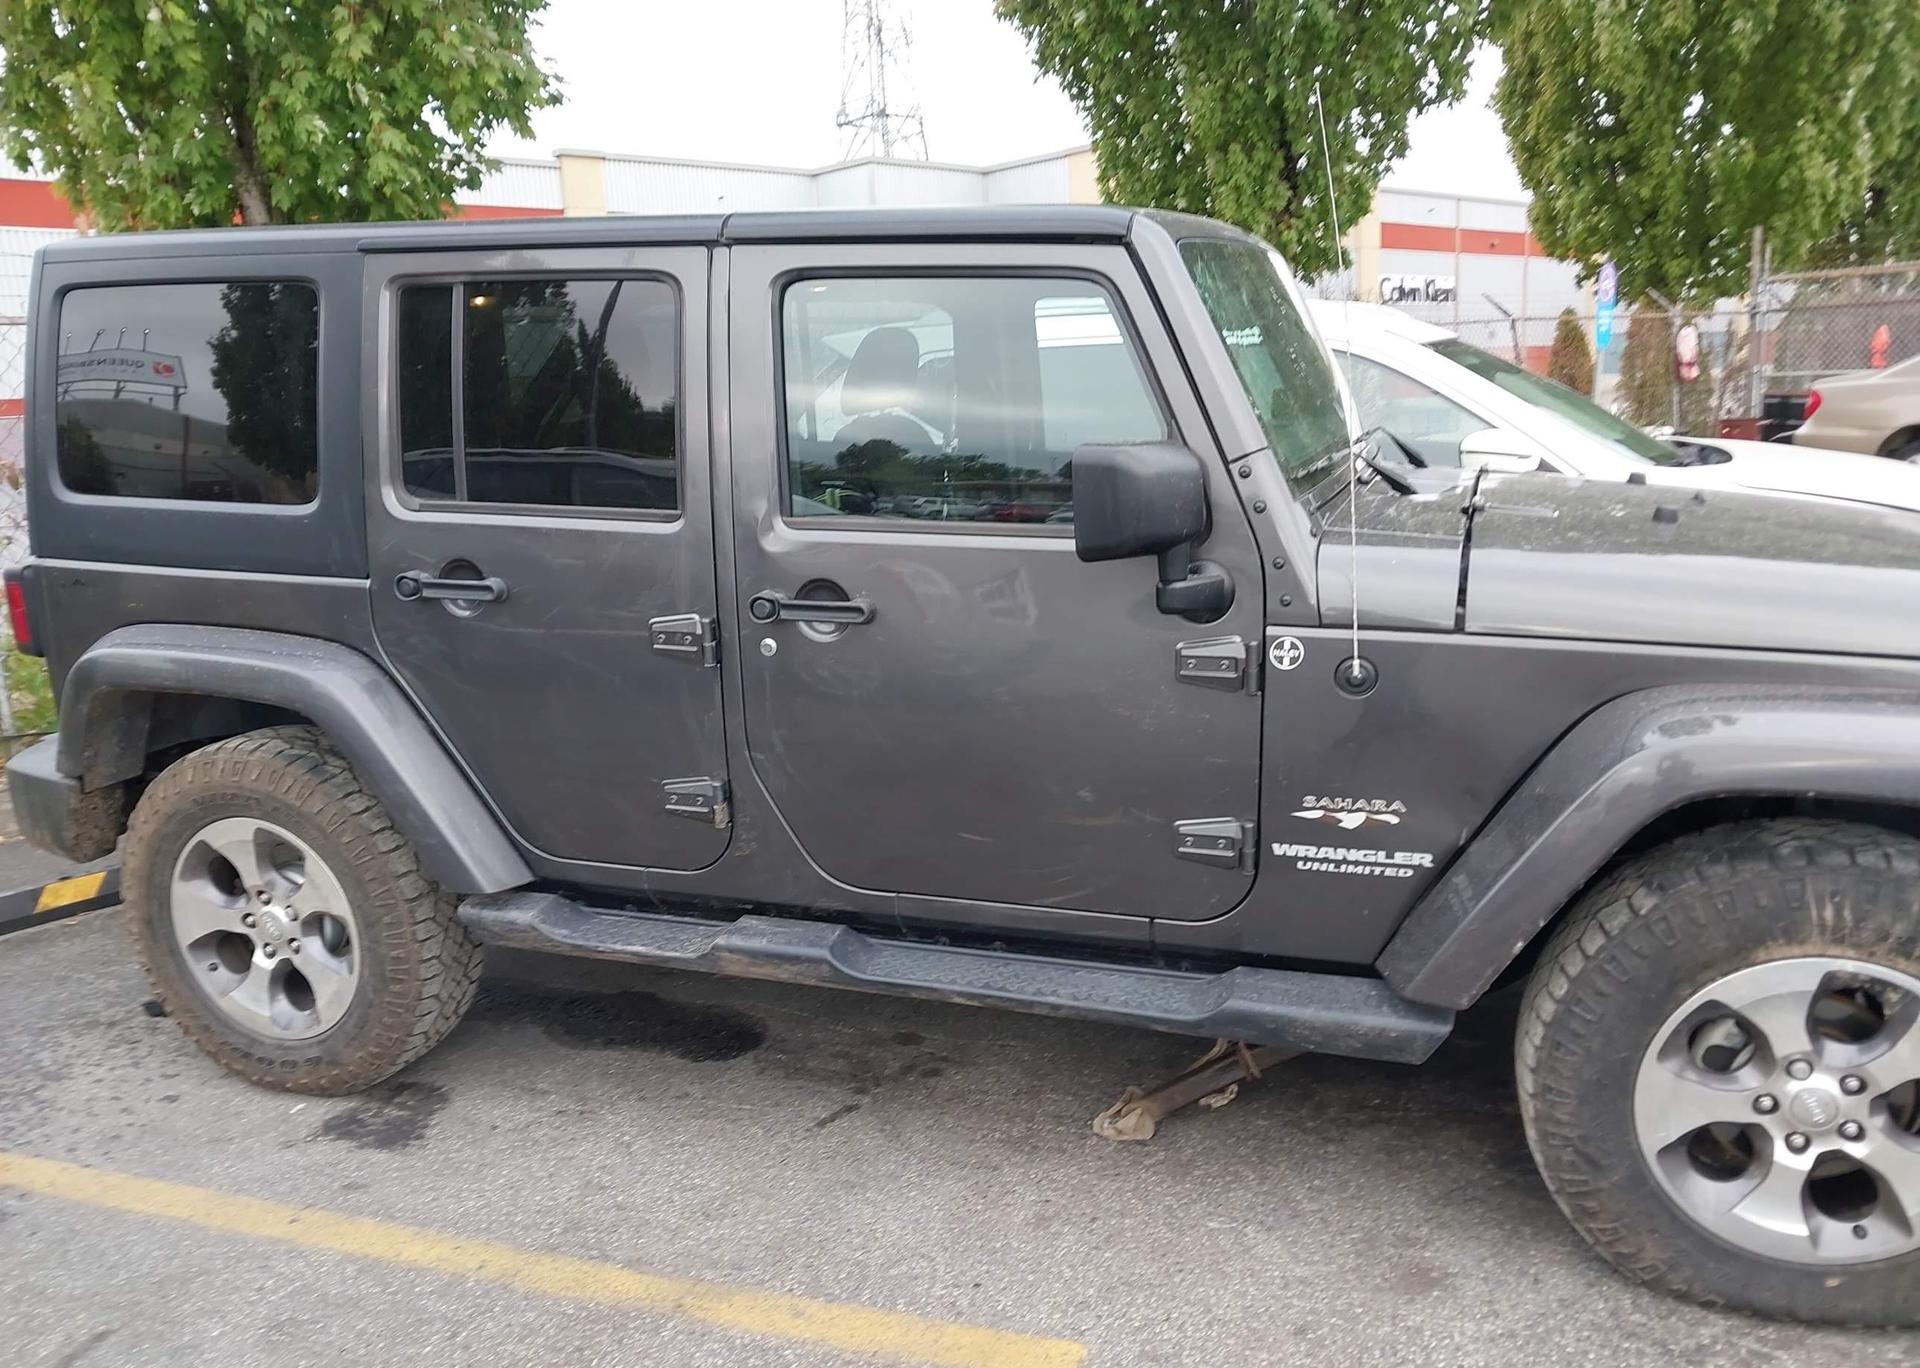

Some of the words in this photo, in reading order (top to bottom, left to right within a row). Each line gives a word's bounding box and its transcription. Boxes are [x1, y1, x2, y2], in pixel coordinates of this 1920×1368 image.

[1302, 795, 1407, 813] SAHARA
[1271, 842, 1435, 868] WRANGLER
[1296, 860, 1414, 878] UNLIMITED
